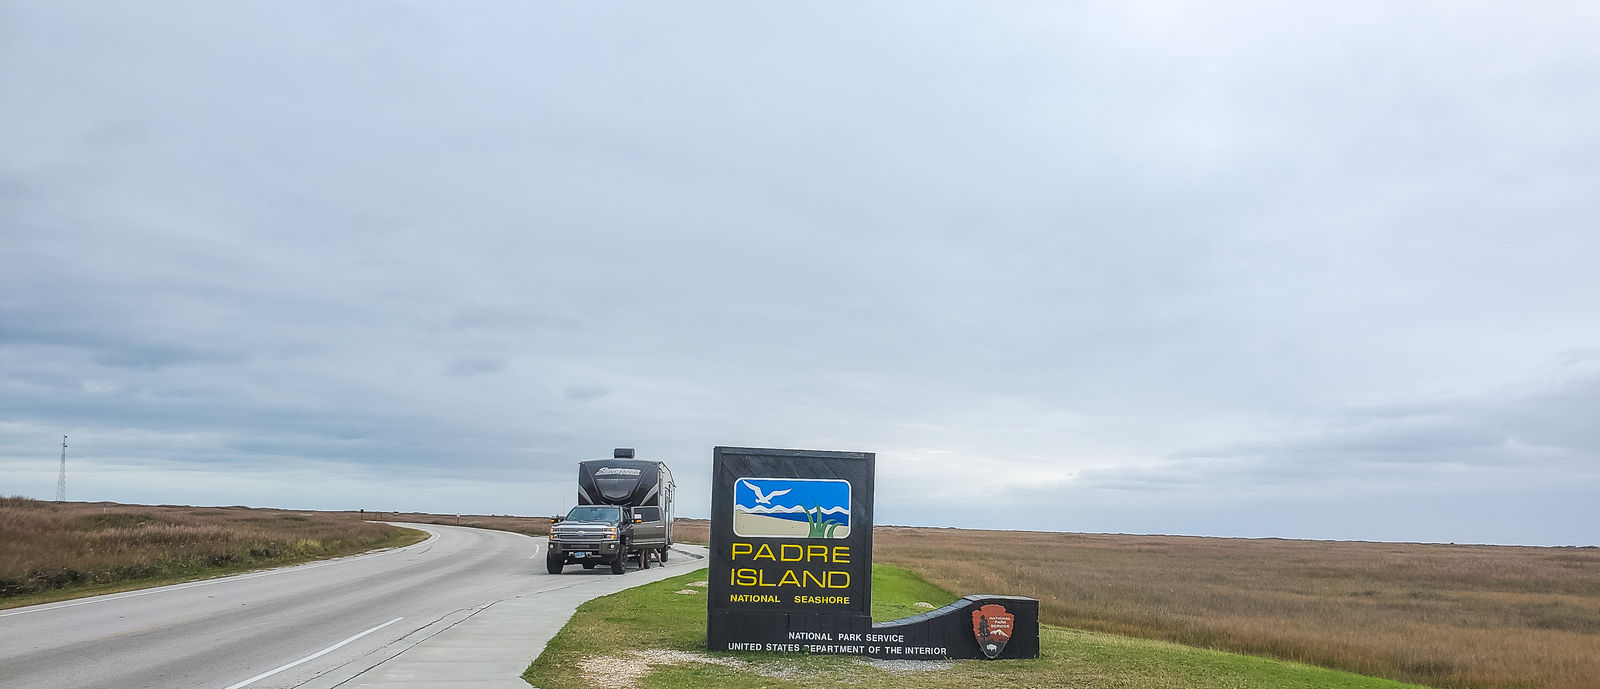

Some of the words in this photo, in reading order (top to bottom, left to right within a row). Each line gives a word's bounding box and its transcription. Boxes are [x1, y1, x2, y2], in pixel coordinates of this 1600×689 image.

[731, 543, 851, 563] PADRE
[730, 568, 851, 589] ISLAND
[730, 594, 781, 603] NATIONAL
[794, 595, 850, 605] SEASHORE
[788, 631, 833, 641] NATIONAL
[838, 633, 862, 642] PARK
[865, 633, 905, 643] SERVICE
[728, 642, 762, 651] UNITED
[765, 643, 800, 652] STATES
[868, 645, 881, 654] OF
[884, 646, 903, 655] THE
[905, 646, 947, 655] INTERIOR
